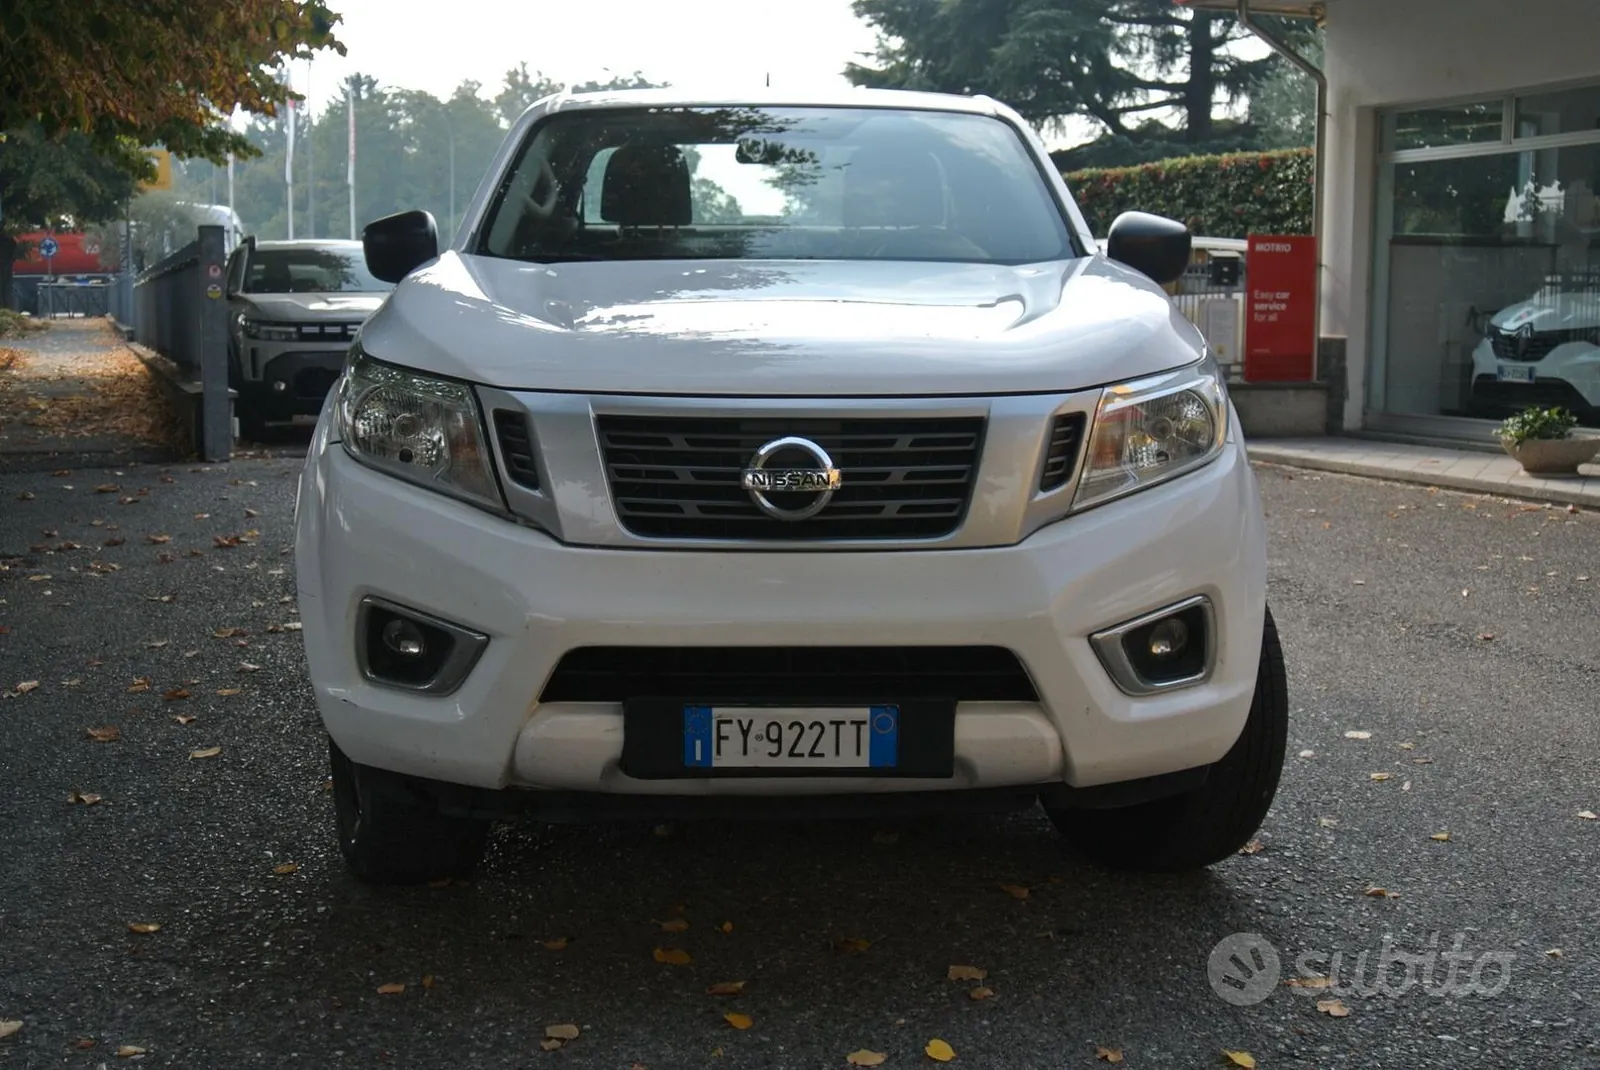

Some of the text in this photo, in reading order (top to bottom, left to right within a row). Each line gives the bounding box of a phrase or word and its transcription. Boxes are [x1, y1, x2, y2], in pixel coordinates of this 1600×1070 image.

[1255, 243, 1292, 253] MOTRIO
[1275, 291, 1290, 300] car
[1254, 301, 1287, 311] service
[752, 473, 831, 486] NISSAN
